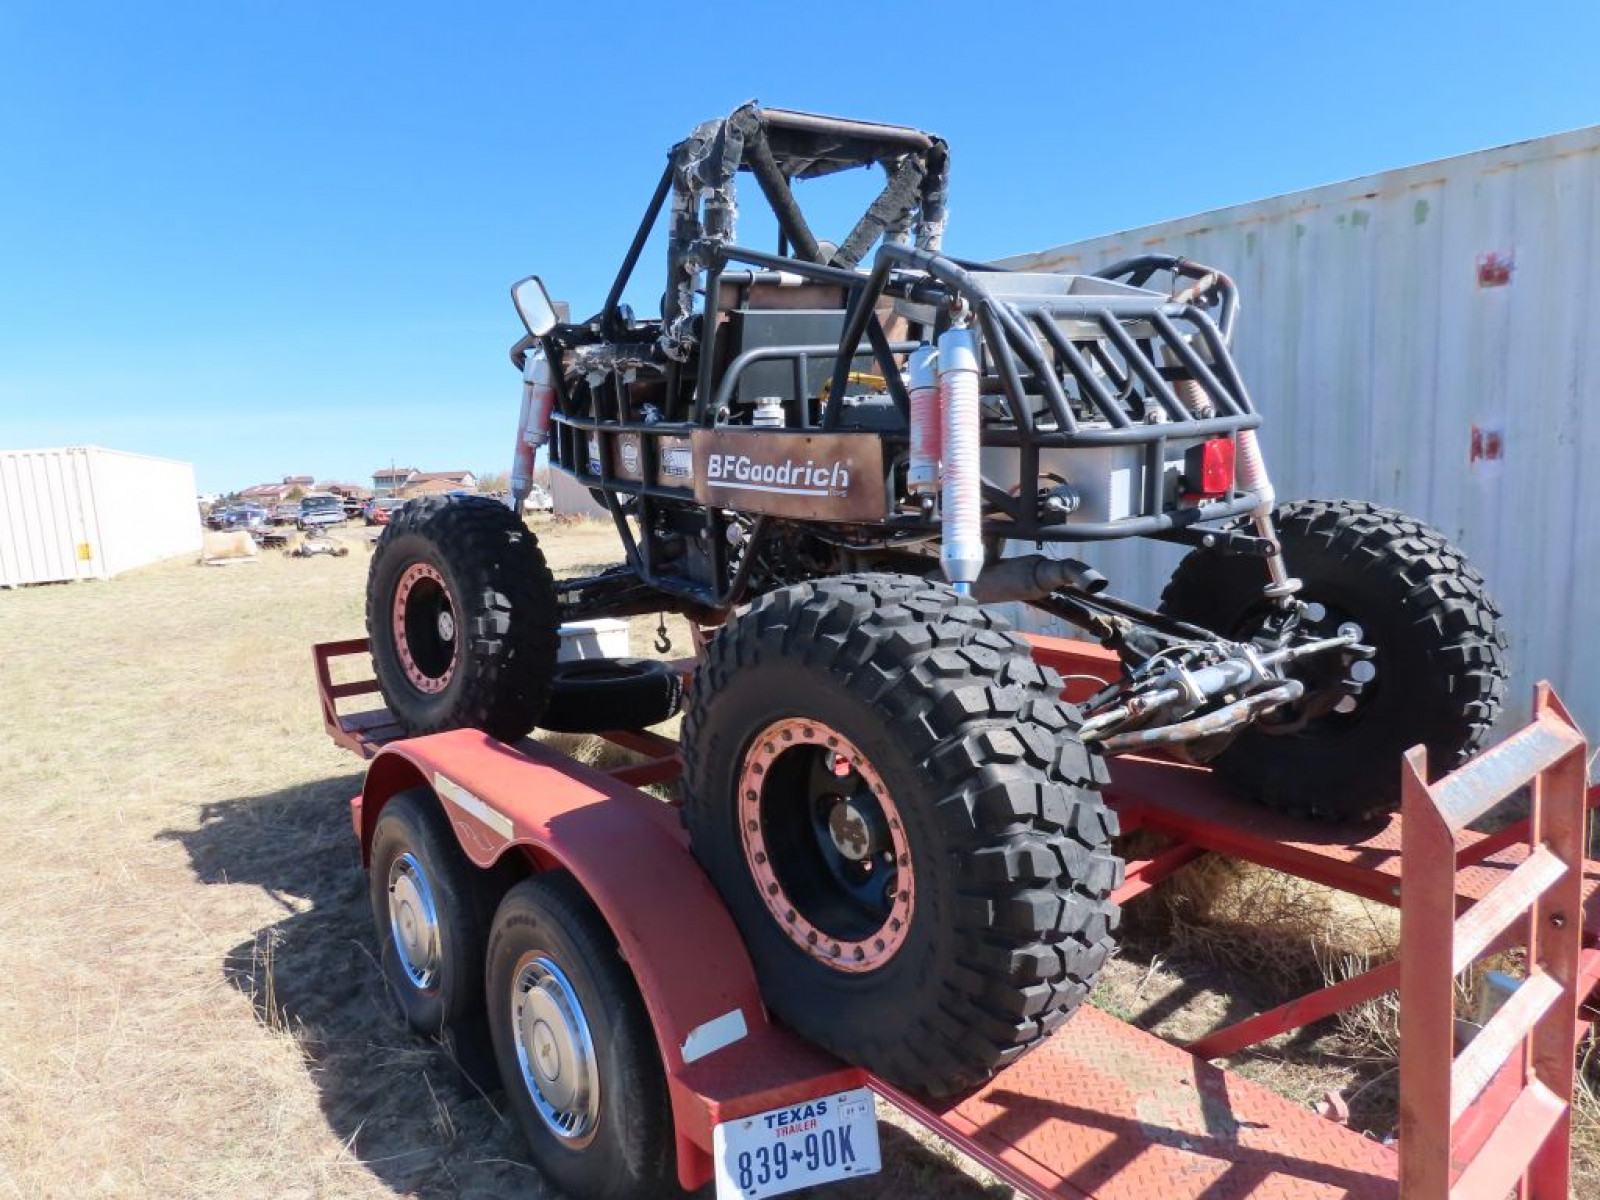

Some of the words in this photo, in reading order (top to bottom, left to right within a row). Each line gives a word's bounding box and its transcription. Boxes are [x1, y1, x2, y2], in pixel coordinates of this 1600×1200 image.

[708, 455, 849, 487] BFGoodrich
[764, 1101, 828, 1129] TEXAS
[775, 1119, 817, 1138] TRAILER
